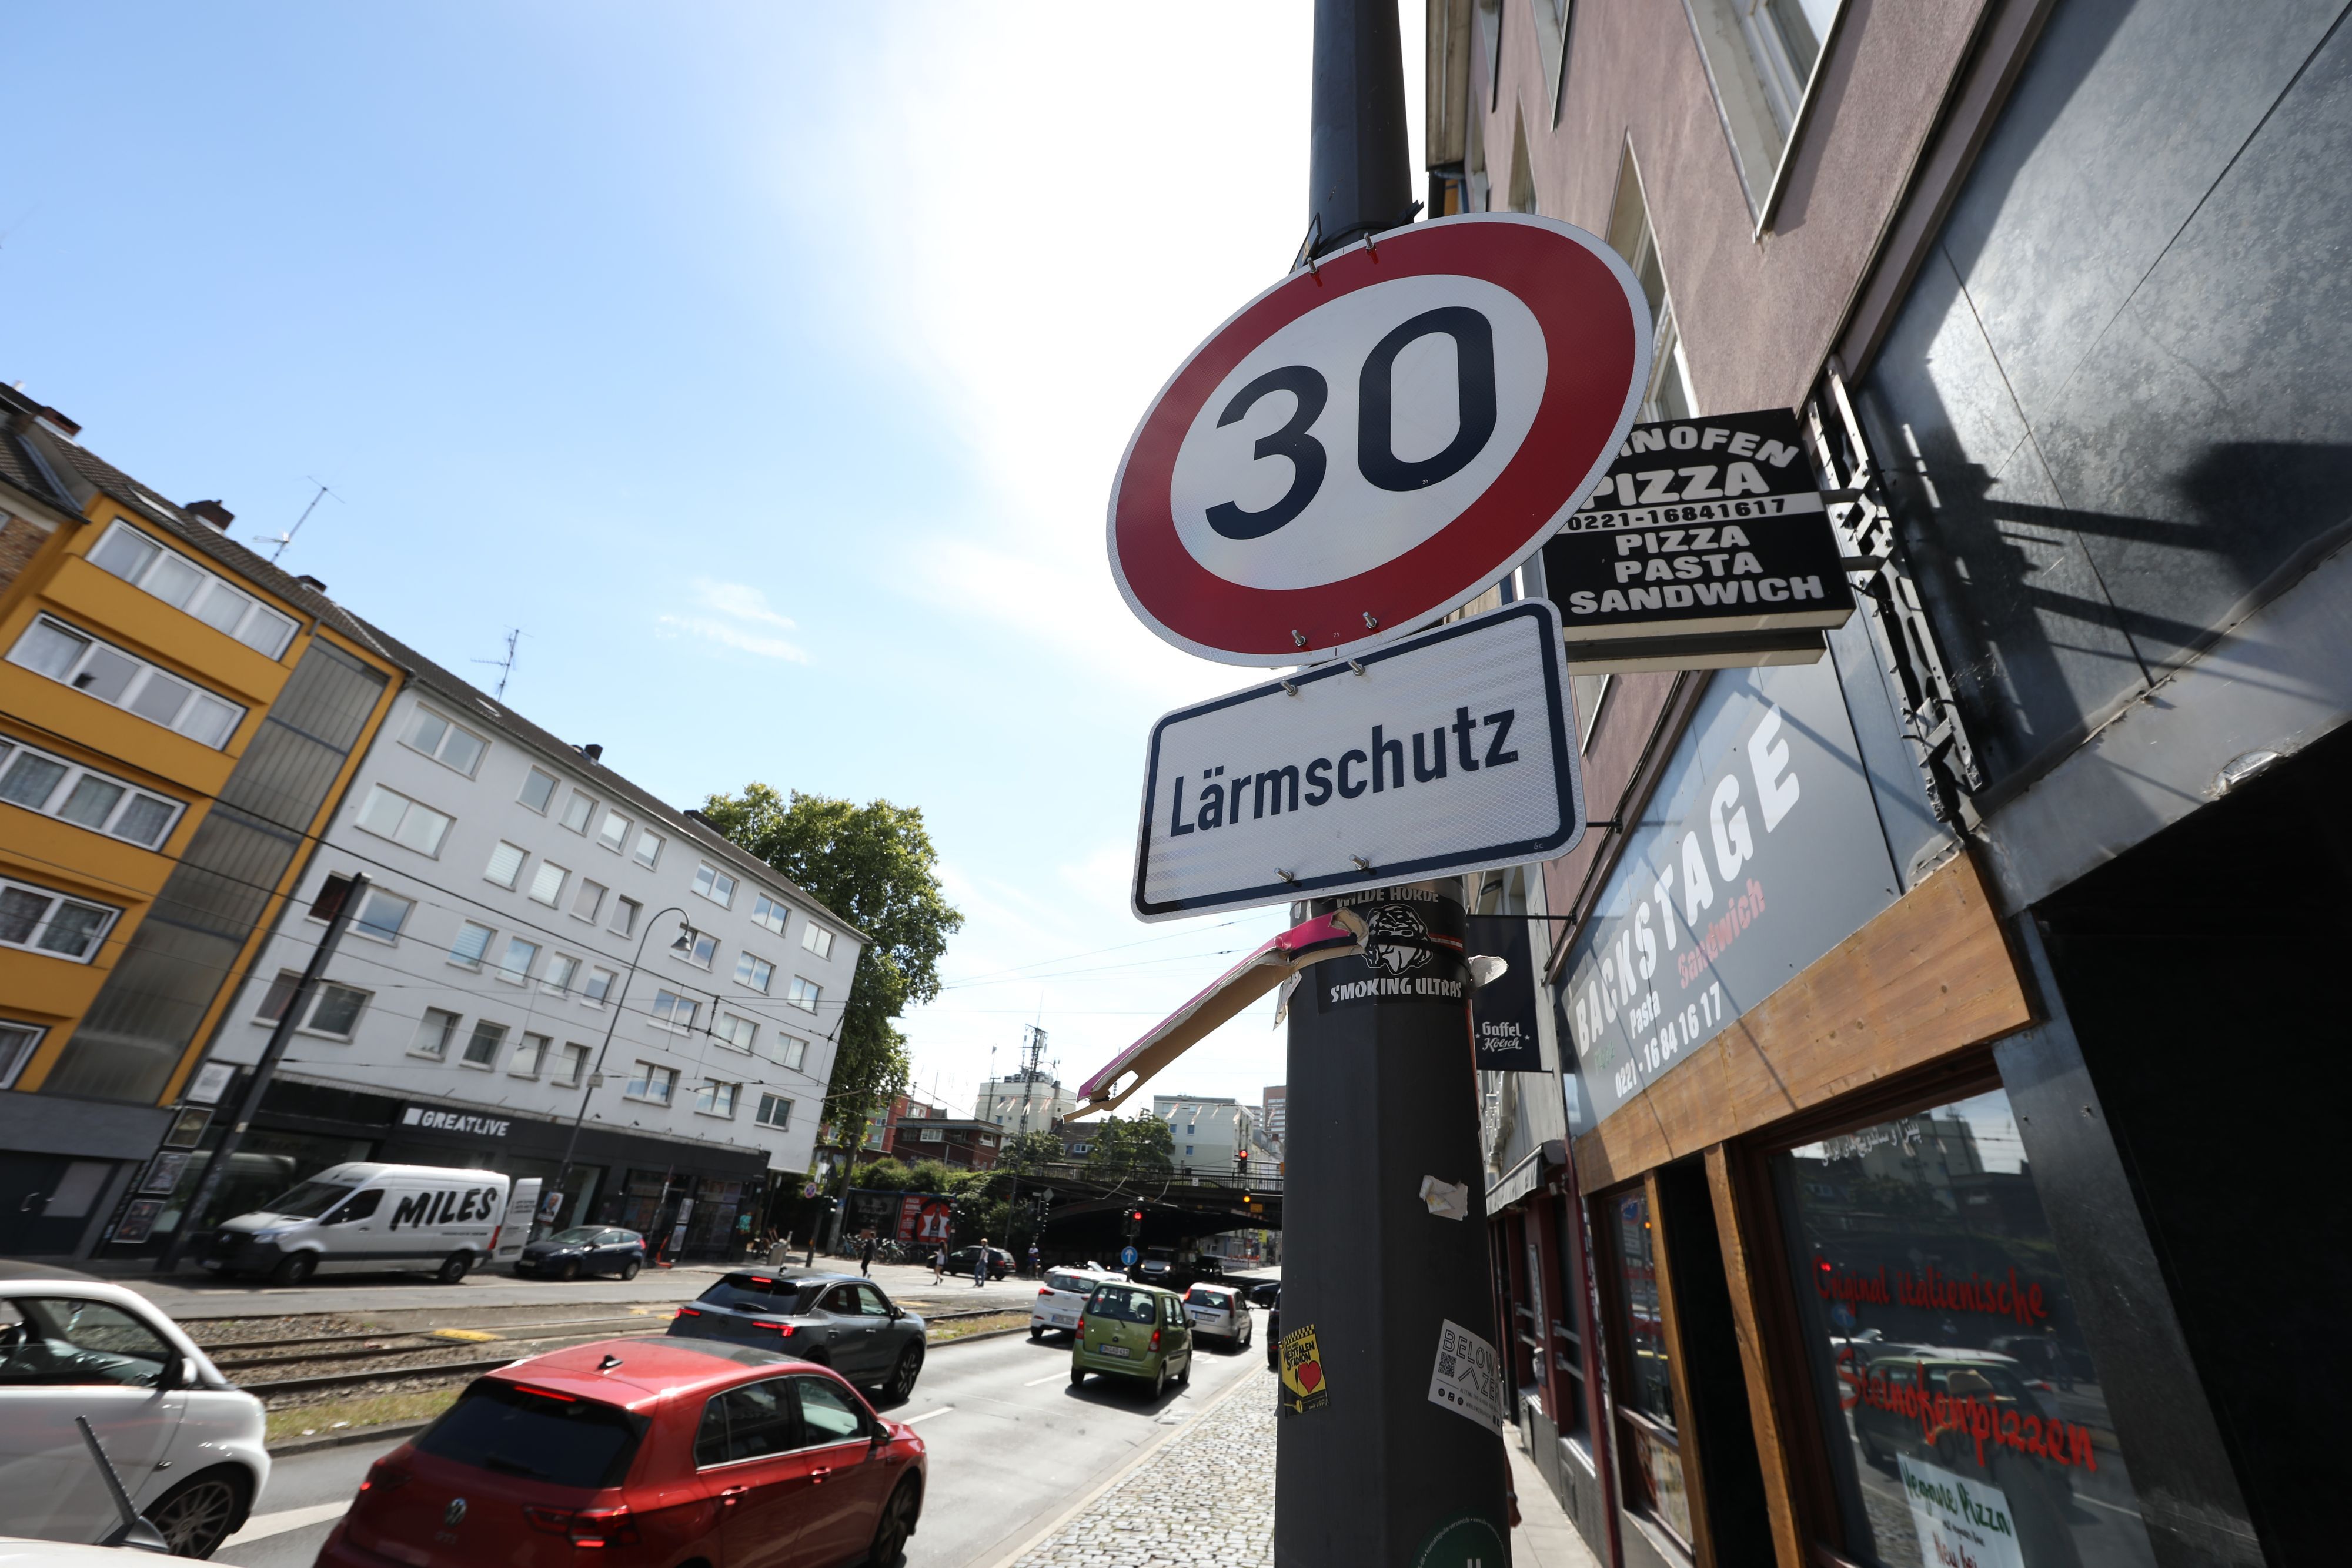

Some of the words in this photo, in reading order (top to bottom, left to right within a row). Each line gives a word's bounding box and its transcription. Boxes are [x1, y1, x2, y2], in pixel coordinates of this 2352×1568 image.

[1205, 306, 1497, 540] 30
[1579, 461, 1770, 510] PIZZA
[1568, 498, 1785, 530] 0221-16841617
[1615, 525, 1751, 556] PIZZA
[1614, 551, 1763, 583] PASTA
[1569, 575, 1825, 614] SANDWICH
[1170, 706, 1519, 837] Lärmschutz
[1336, 889, 1384, 908] WILDE
[1389, 887, 1439, 902] HORDE
[1575, 703, 1800, 1058] BACKSTAGE
[1677, 877, 1766, 990] Sandwich
[1330, 977, 1412, 1003] SMOKING
[1415, 977, 1462, 998] ULTRAS
[1482, 1021, 1522, 1038] Gaffel
[1629, 989, 1661, 1040] Pasta
[1482, 1037, 1523, 1052] Kölsch
[1615, 1057, 1638, 1099] 0221
[1643, 1037, 1661, 1074] 16
[1660, 1021, 1678, 1061] 84
[1678, 1002, 1699, 1045] 16
[1699, 981, 1722, 1028] 17
[421, 1111, 512, 1137] GREATLIVE
[389, 1186, 498, 1232] MILES
[1812, 1256, 1890, 1318] Original
[1897, 1266, 2049, 1326] italienische
[1283, 1340, 1315, 1363] WESTFALEN
[1287, 1352, 1312, 1372] STADION
[1442, 1329, 1496, 1376] BELOW
[1838, 1347, 2097, 1473] Steinofenpizzen
